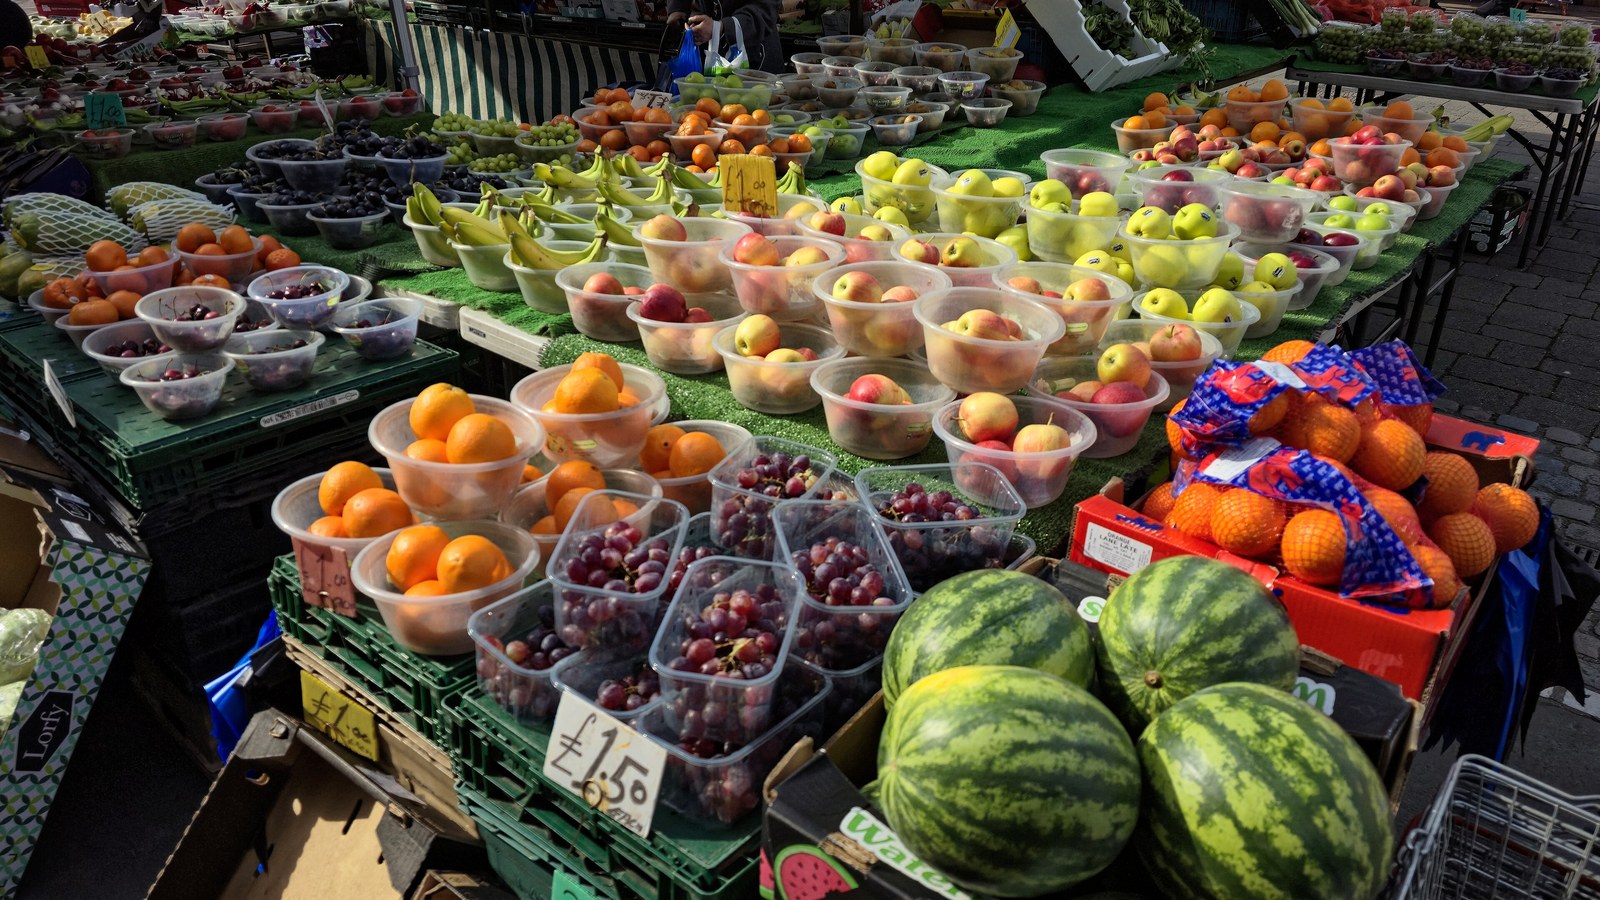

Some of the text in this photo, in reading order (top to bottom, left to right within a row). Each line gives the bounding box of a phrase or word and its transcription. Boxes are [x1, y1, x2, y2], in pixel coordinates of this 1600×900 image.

[1100, 534, 1117, 546] LANE
[1120, 542, 1138, 554] LATE
[23, 704, 69, 760] Lorfy
[550, 712, 650, 806] £1.50
